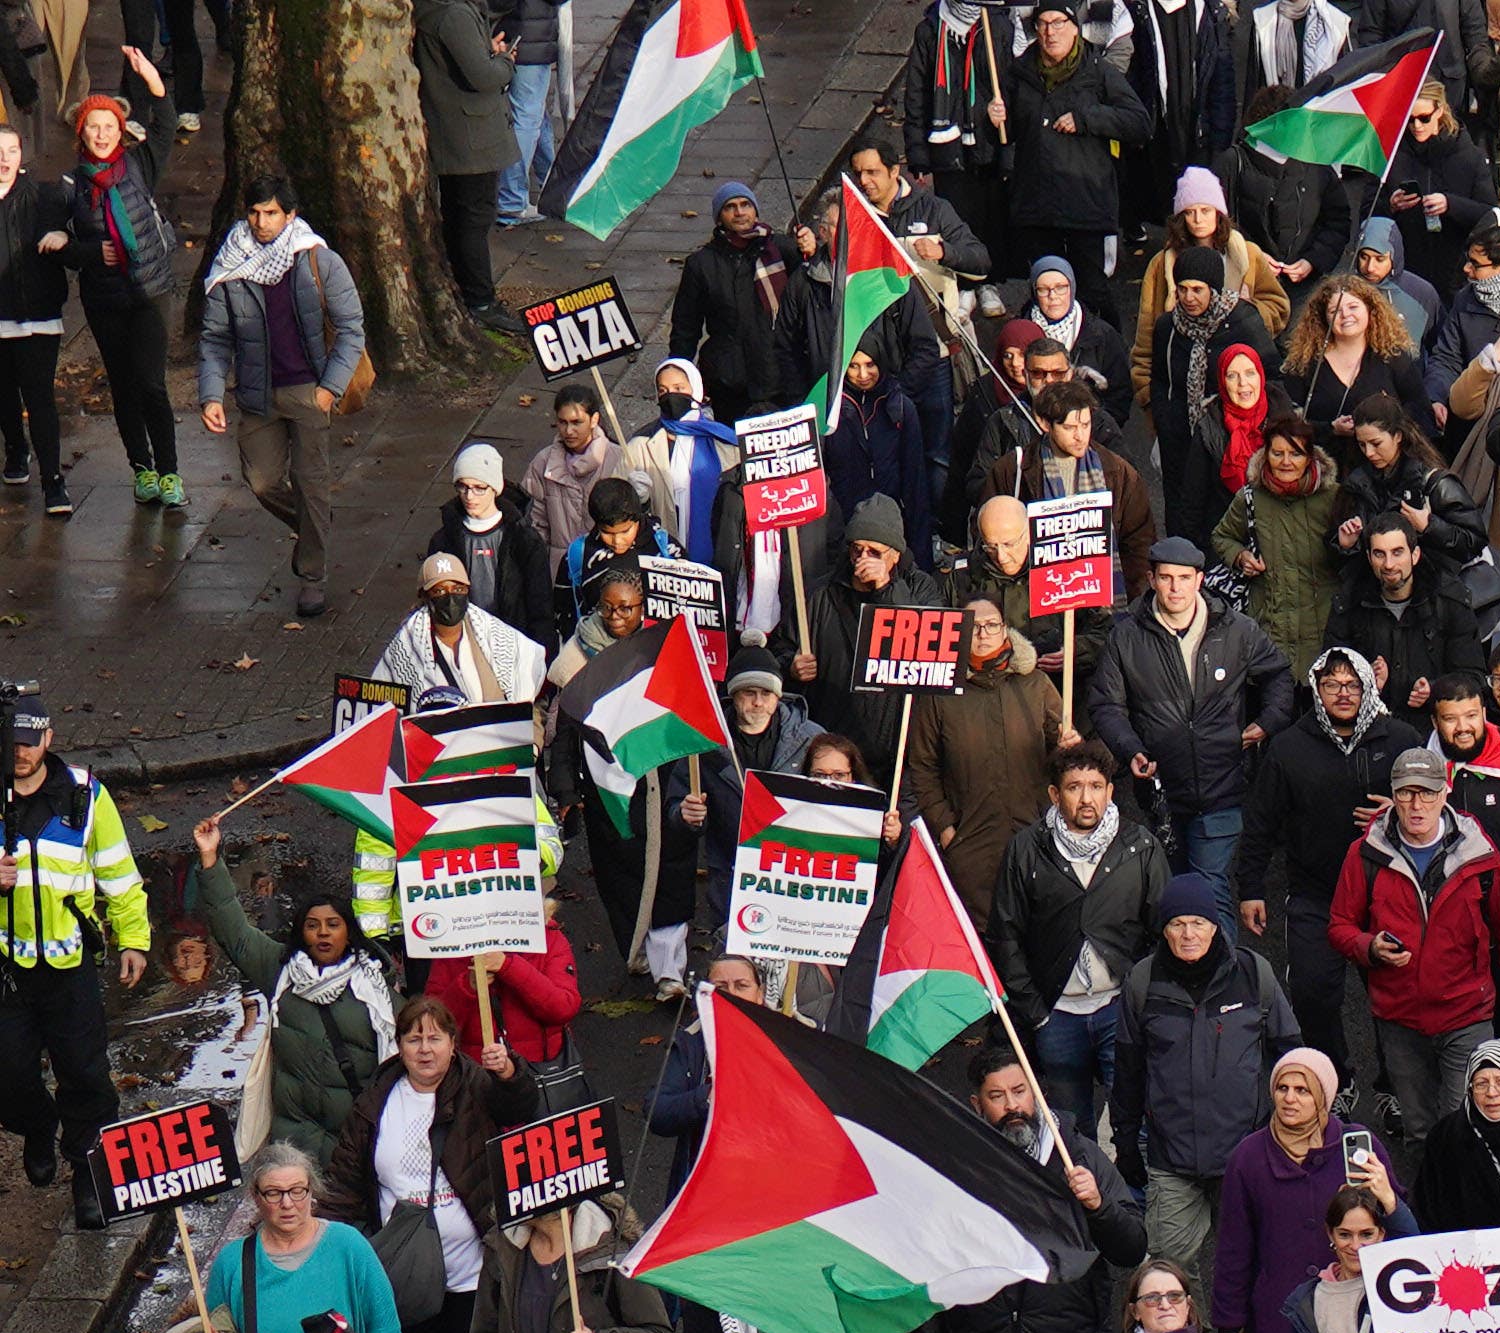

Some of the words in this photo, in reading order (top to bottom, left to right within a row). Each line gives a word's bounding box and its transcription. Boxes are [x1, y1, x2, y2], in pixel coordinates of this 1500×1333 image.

[525, 303, 555, 326] STOP
[556, 282, 615, 314] BOMBING
[534, 300, 635, 372] GAZA
[745, 420, 810, 454] FREEDOM
[746, 449, 817, 481] PALESTINE
[1037, 507, 1102, 536] FREEDOM
[1033, 536, 1107, 564] PALESTINE
[869, 609, 962, 662] FREE
[865, 658, 955, 686] PALESTINE
[419, 842, 520, 880] FREE
[759, 841, 858, 882] FREE
[407, 875, 535, 902] PALESTINE
[740, 873, 868, 906] PALESTINE
[101, 1105, 221, 1185] FREE
[501, 1106, 607, 1190] FREE
[114, 1158, 226, 1211] PALESTINE
[509, 1159, 609, 1216] PALESTINE
